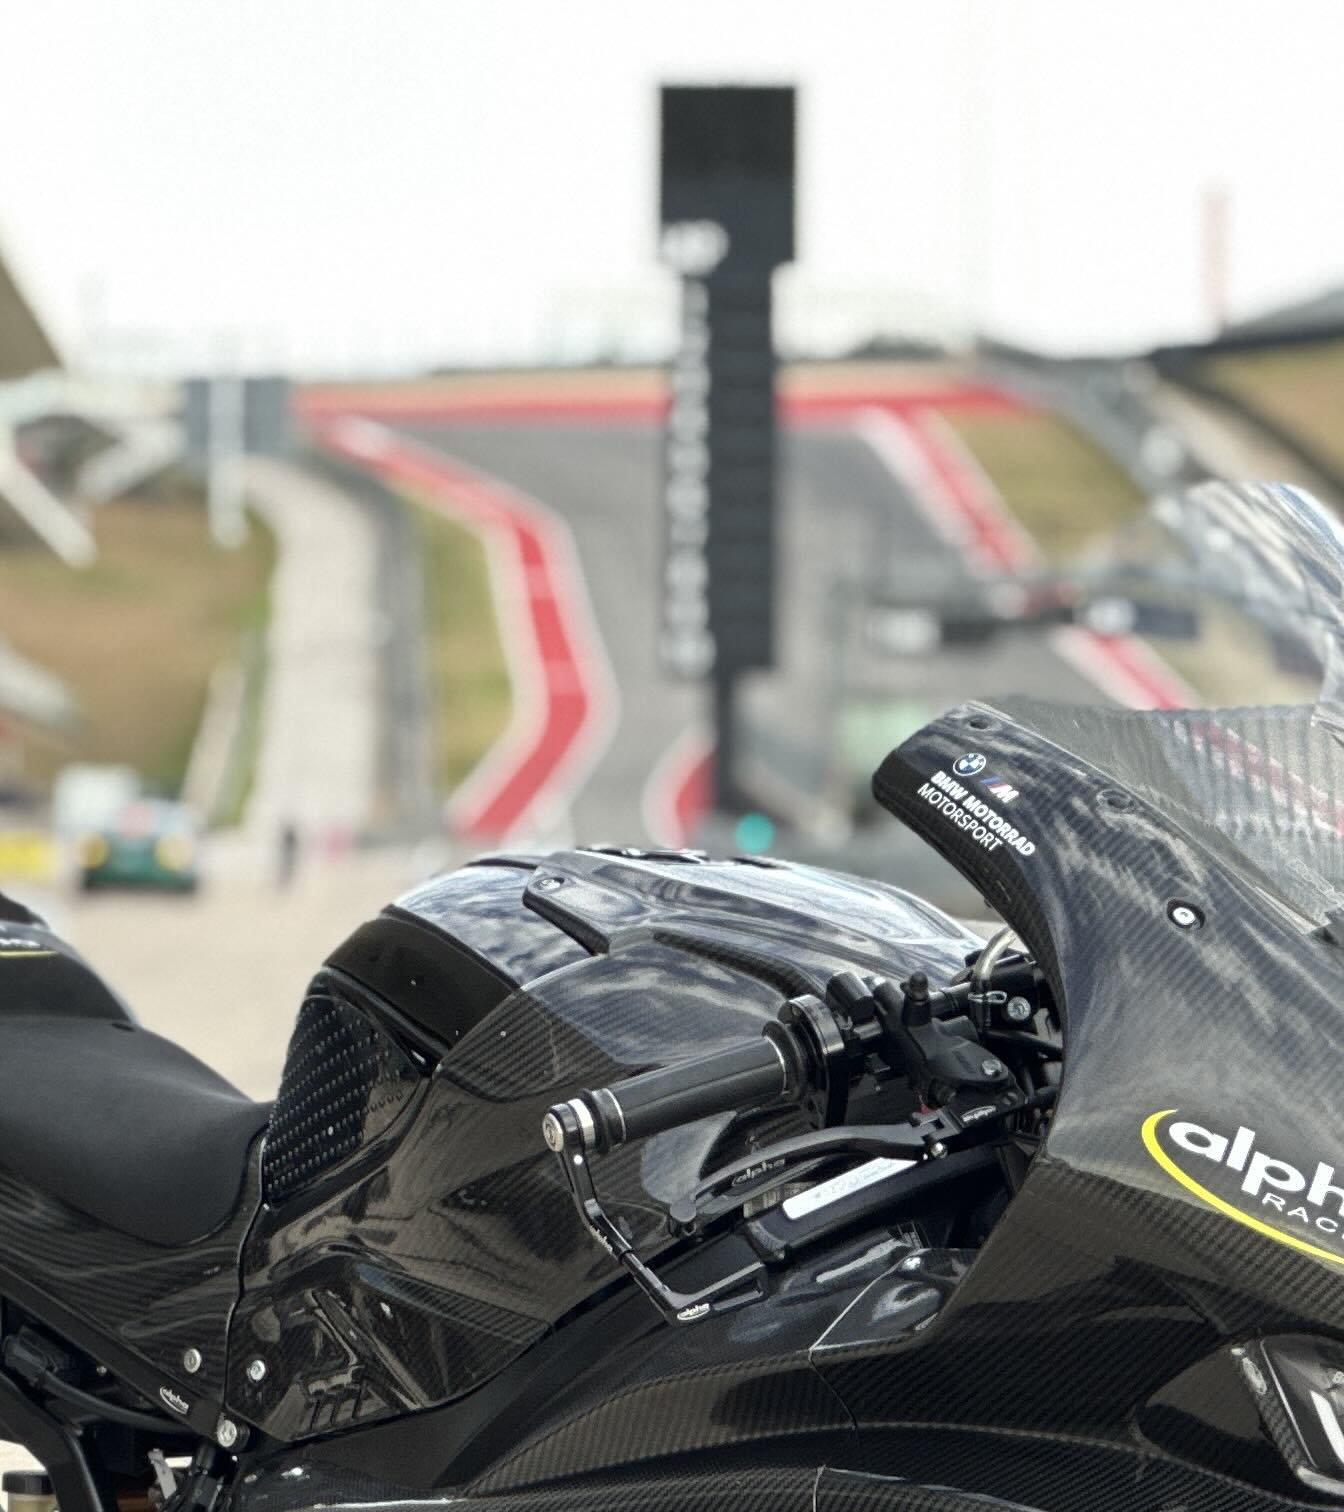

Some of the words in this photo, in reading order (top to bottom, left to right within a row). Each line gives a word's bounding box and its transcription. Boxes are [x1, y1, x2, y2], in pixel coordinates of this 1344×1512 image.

[917, 782, 1003, 851] MOTORSPORT
[931, 770, 968, 800] BMW
[962, 795, 1036, 856] MOTORRAD
[736, 1158, 786, 1183] alpha
